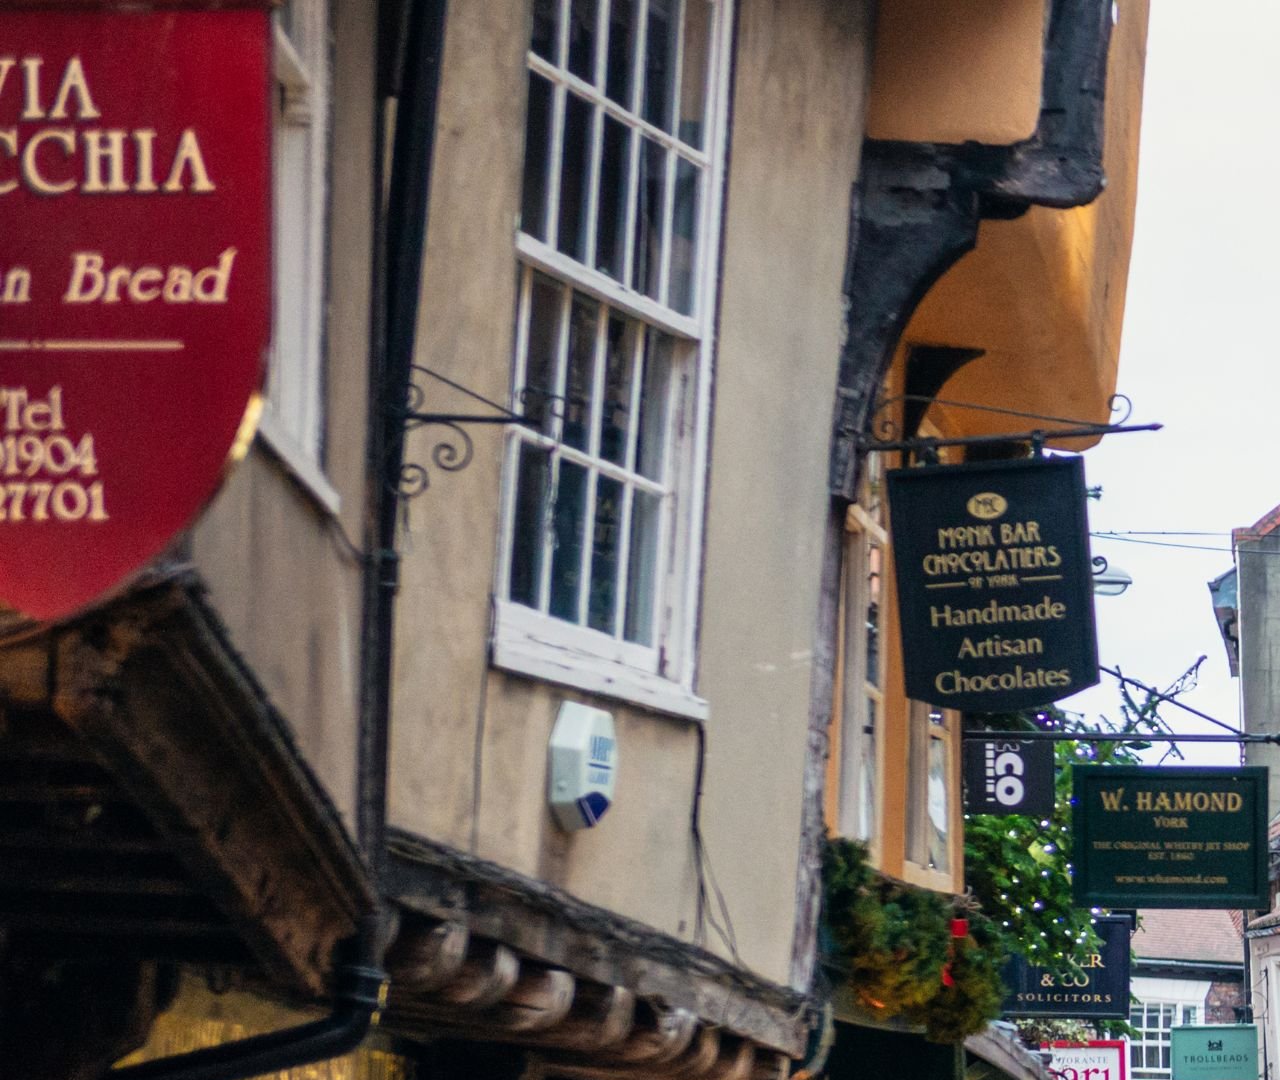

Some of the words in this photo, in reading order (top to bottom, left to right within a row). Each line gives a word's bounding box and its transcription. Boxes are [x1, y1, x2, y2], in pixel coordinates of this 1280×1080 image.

[65, 247, 238, 304] Bread
[0, 385, 65, 431] Tel
[0, 433, 99, 477] 1904
[938, 525, 996, 549] MONK
[1000, 520, 1041, 545] BAR
[923, 545, 1062, 576] CHOCOLATIERS
[968, 576, 983, 589] OF
[986, 573, 1019, 588] YORK
[930, 595, 1067, 627] Handmade
[957, 634, 1044, 659] Artisan
[935, 664, 1072, 694] Chocolates
[1101, 788, 1130, 812] W.
[1137, 791, 1244, 812] HAMOND
[1154, 817, 1189, 829] YORK
[1093, 841, 1112, 849] THE
[1041, 974, 1056, 987] &
[1062, 973, 1089, 987] CO
[1017, 993, 1112, 1003] SOLICITORS
[1184, 1055, 1249, 1063] TROLLBEADS
